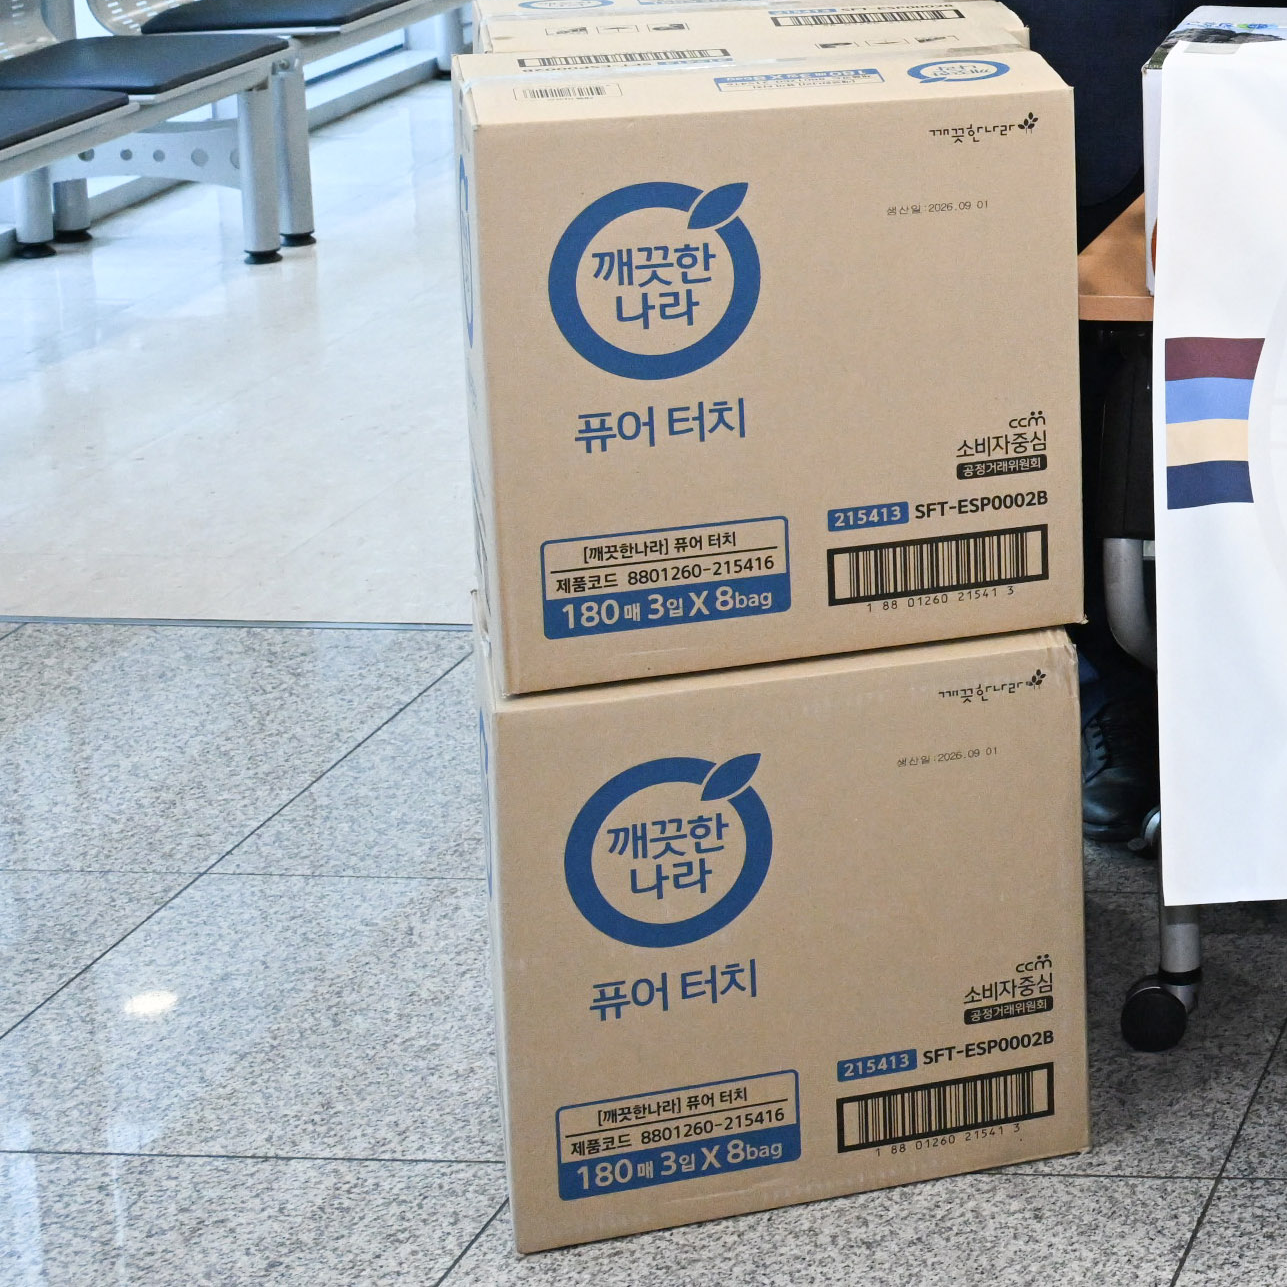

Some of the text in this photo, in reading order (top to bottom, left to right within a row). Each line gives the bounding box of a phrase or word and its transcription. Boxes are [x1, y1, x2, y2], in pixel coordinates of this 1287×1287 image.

[592, 243, 717, 289] 깨끗한
[615, 290, 699, 330] 나라
[574, 398, 747, 454] 퓨어 터치
[956, 431, 1048, 460] 소비자중심
[962, 457, 1042, 477] 공정거래위원회
[832, 491, 1048, 527] 215413 SFT-ESP0002B
[606, 813, 729, 859] 깨끗한
[630, 859, 713, 901] 나라
[589, 959, 758, 1022] 퓨어 터치
[963, 974, 1054, 1005] 소비자중심
[970, 999, 1048, 1022] 공정거래위원회
[843, 1029, 1055, 1078] 215413 SFT-ESP0002B
